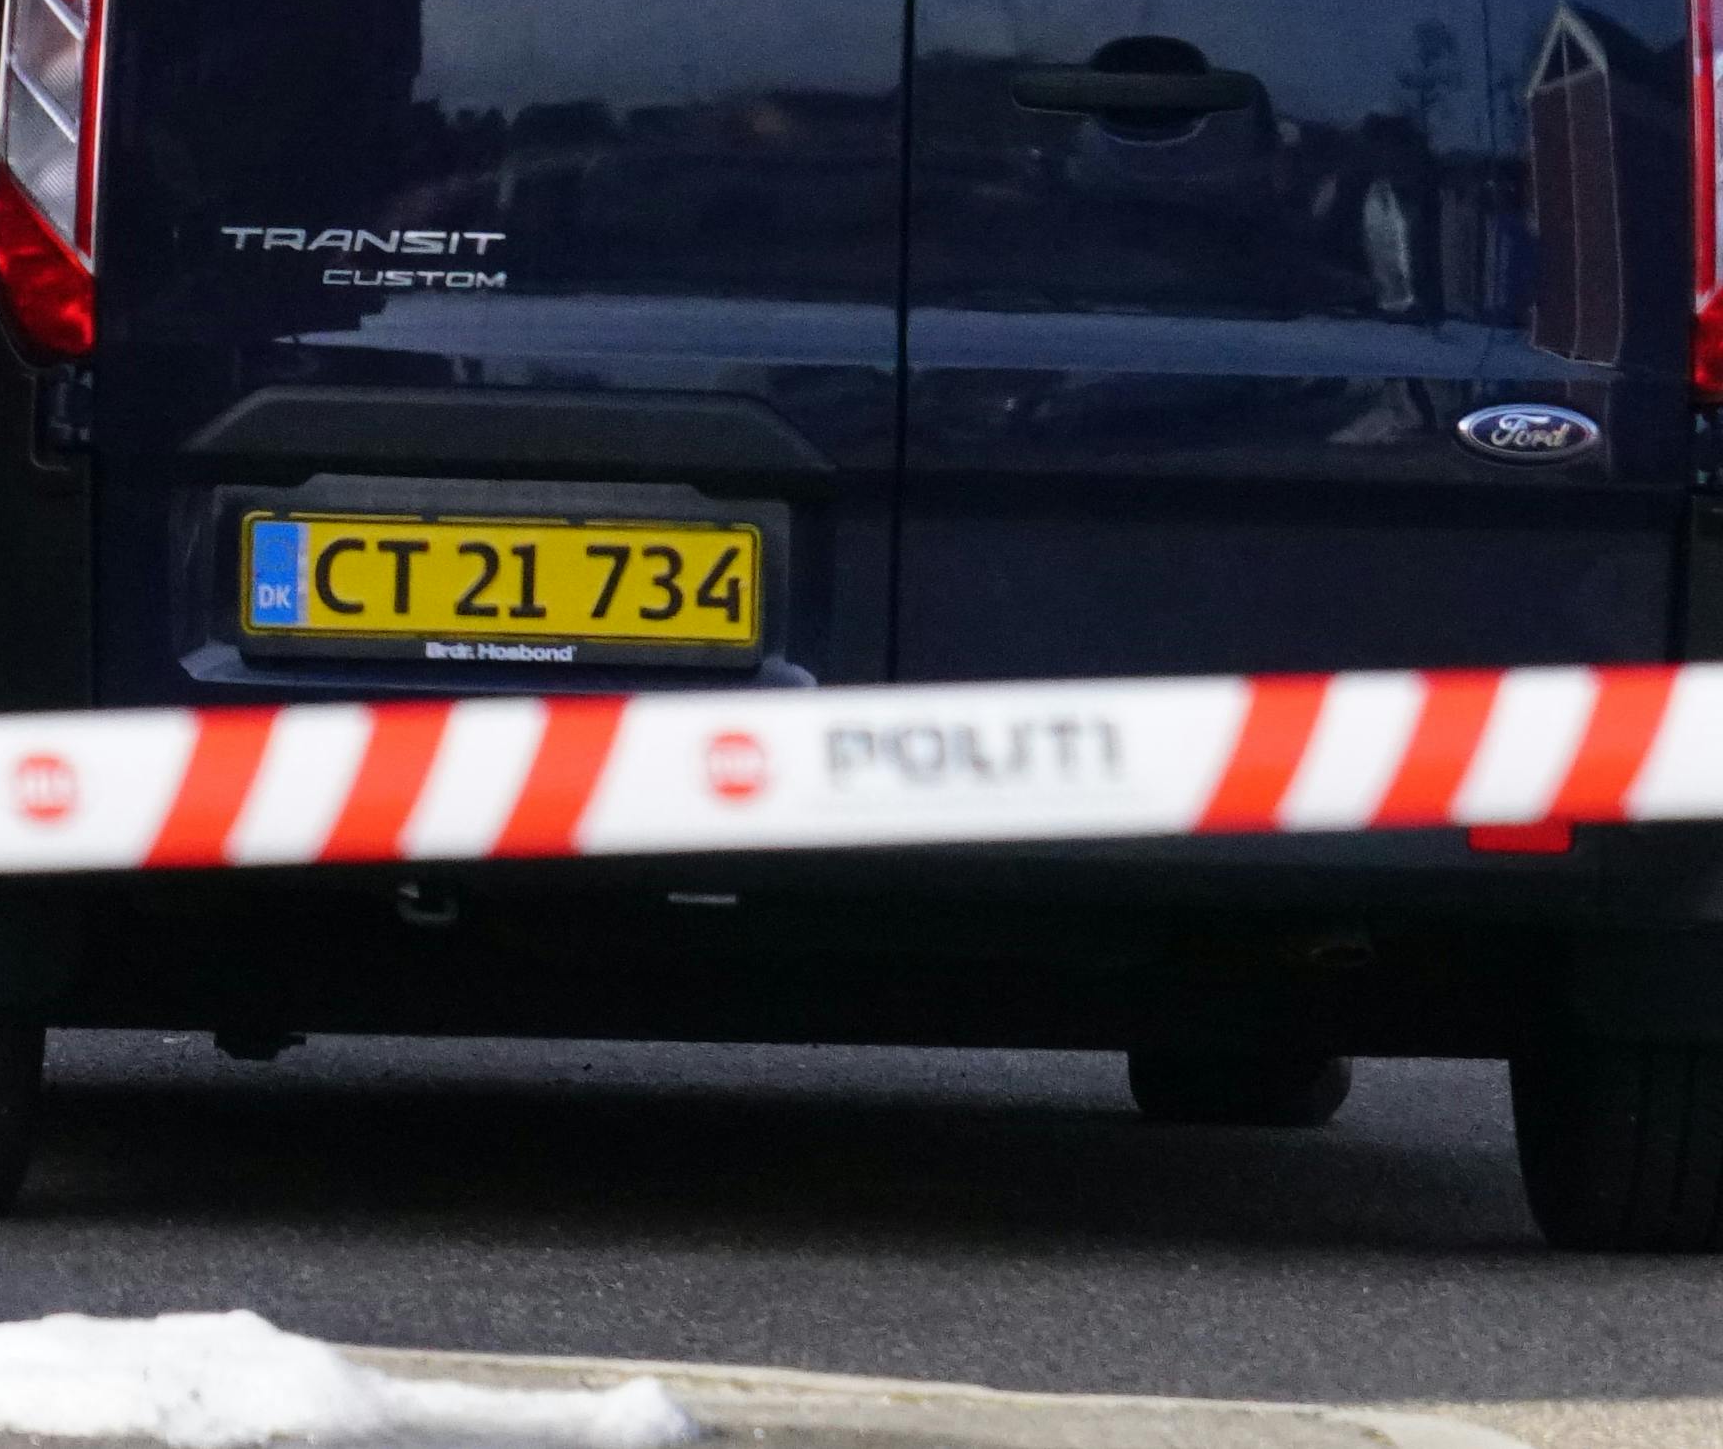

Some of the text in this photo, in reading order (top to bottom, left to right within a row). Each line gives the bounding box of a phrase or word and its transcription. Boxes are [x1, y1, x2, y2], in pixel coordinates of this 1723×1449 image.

[221, 226, 507, 255] TRANSIT
[322, 269, 508, 289] CUSTOM
[1490, 412, 1571, 448] Ford
[314, 536, 743, 624] CT 21 734
[257, 583, 292, 610] DK
[826, 721, 1121, 785] POLITI
